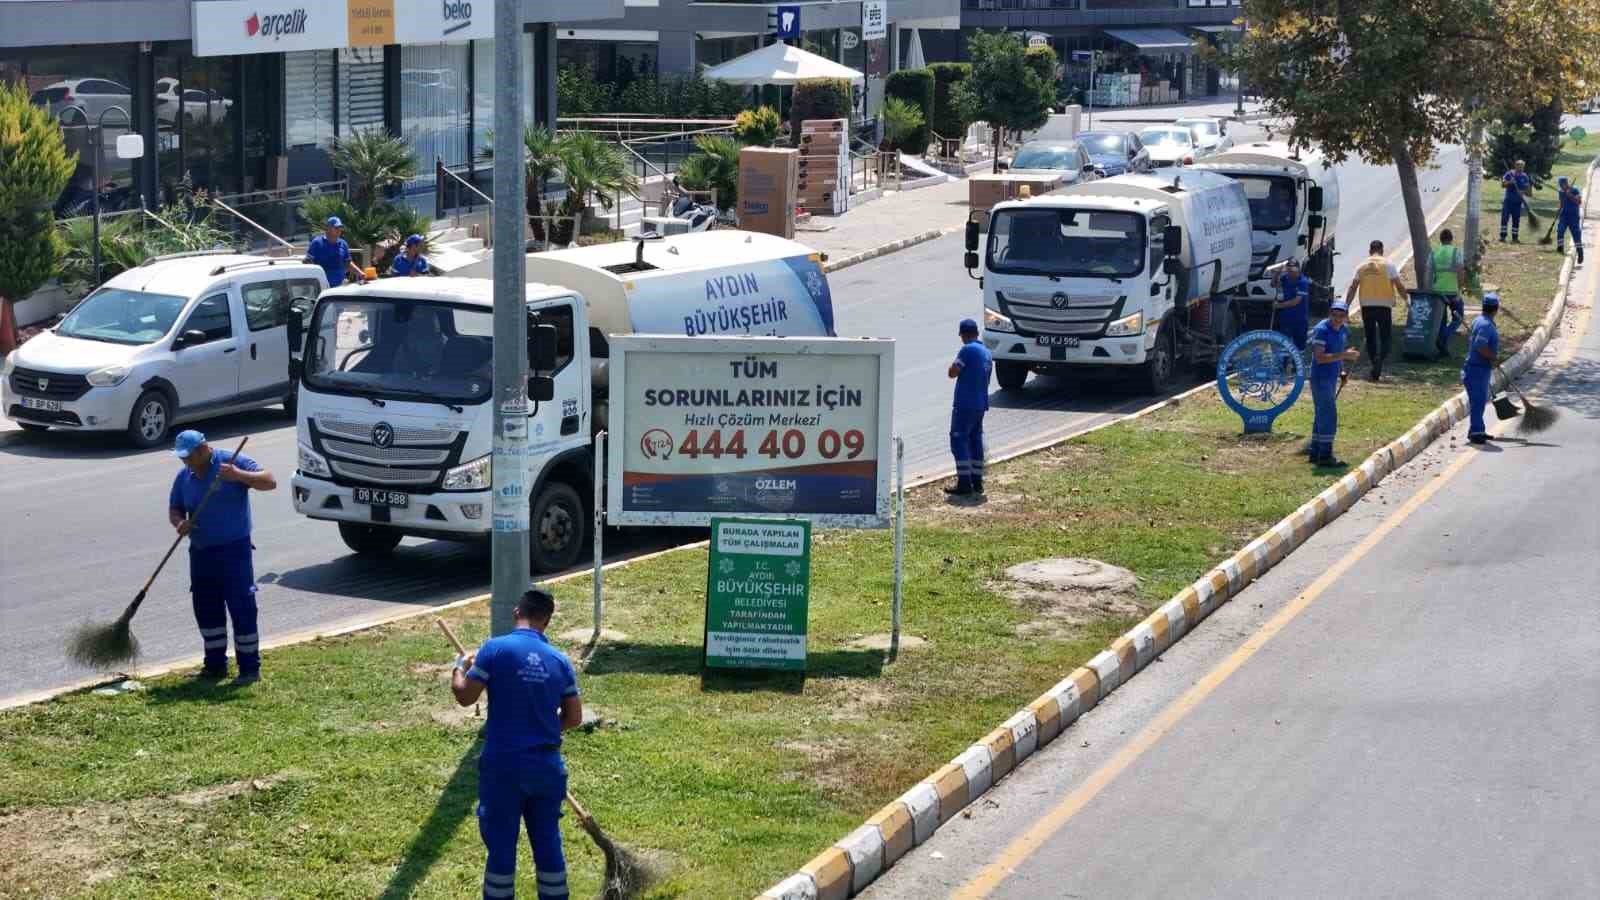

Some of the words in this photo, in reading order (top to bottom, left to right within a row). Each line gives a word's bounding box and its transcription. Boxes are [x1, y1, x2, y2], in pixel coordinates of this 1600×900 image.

[443, 0, 471, 19] beko
[261, 9, 308, 39] arçelik
[705, 272, 759, 301] AYDIN
[684, 296, 788, 336] BÜYÜKŞEHİR
[730, 355, 778, 379] TÜM
[644, 388, 810, 407] SORUNLARINIZ
[815, 384, 862, 411] İÇİN
[684, 412, 714, 427] Hızlı
[718, 412, 765, 428] Çözüm
[768, 412, 821, 427] Merkezi
[678, 429, 748, 460] 444
[758, 428, 806, 460] 40
[817, 428, 865, 460] 09
[358, 489, 370, 501] 09
[372, 491, 387, 503] KJ
[722, 527, 760, 537] BURADA
[762, 529, 799, 538] YAPILAN
[722, 537, 741, 546] TÜM
[743, 540, 800, 550] ÇALIŞMALAR
[717, 577, 805, 599] BÜYÜKŞEHİR
[734, 596, 787, 609] BELEDİYESİ
[730, 609, 787, 619] TARAFINDAN
[722, 621, 793, 632] YAPILMAKTADIR
